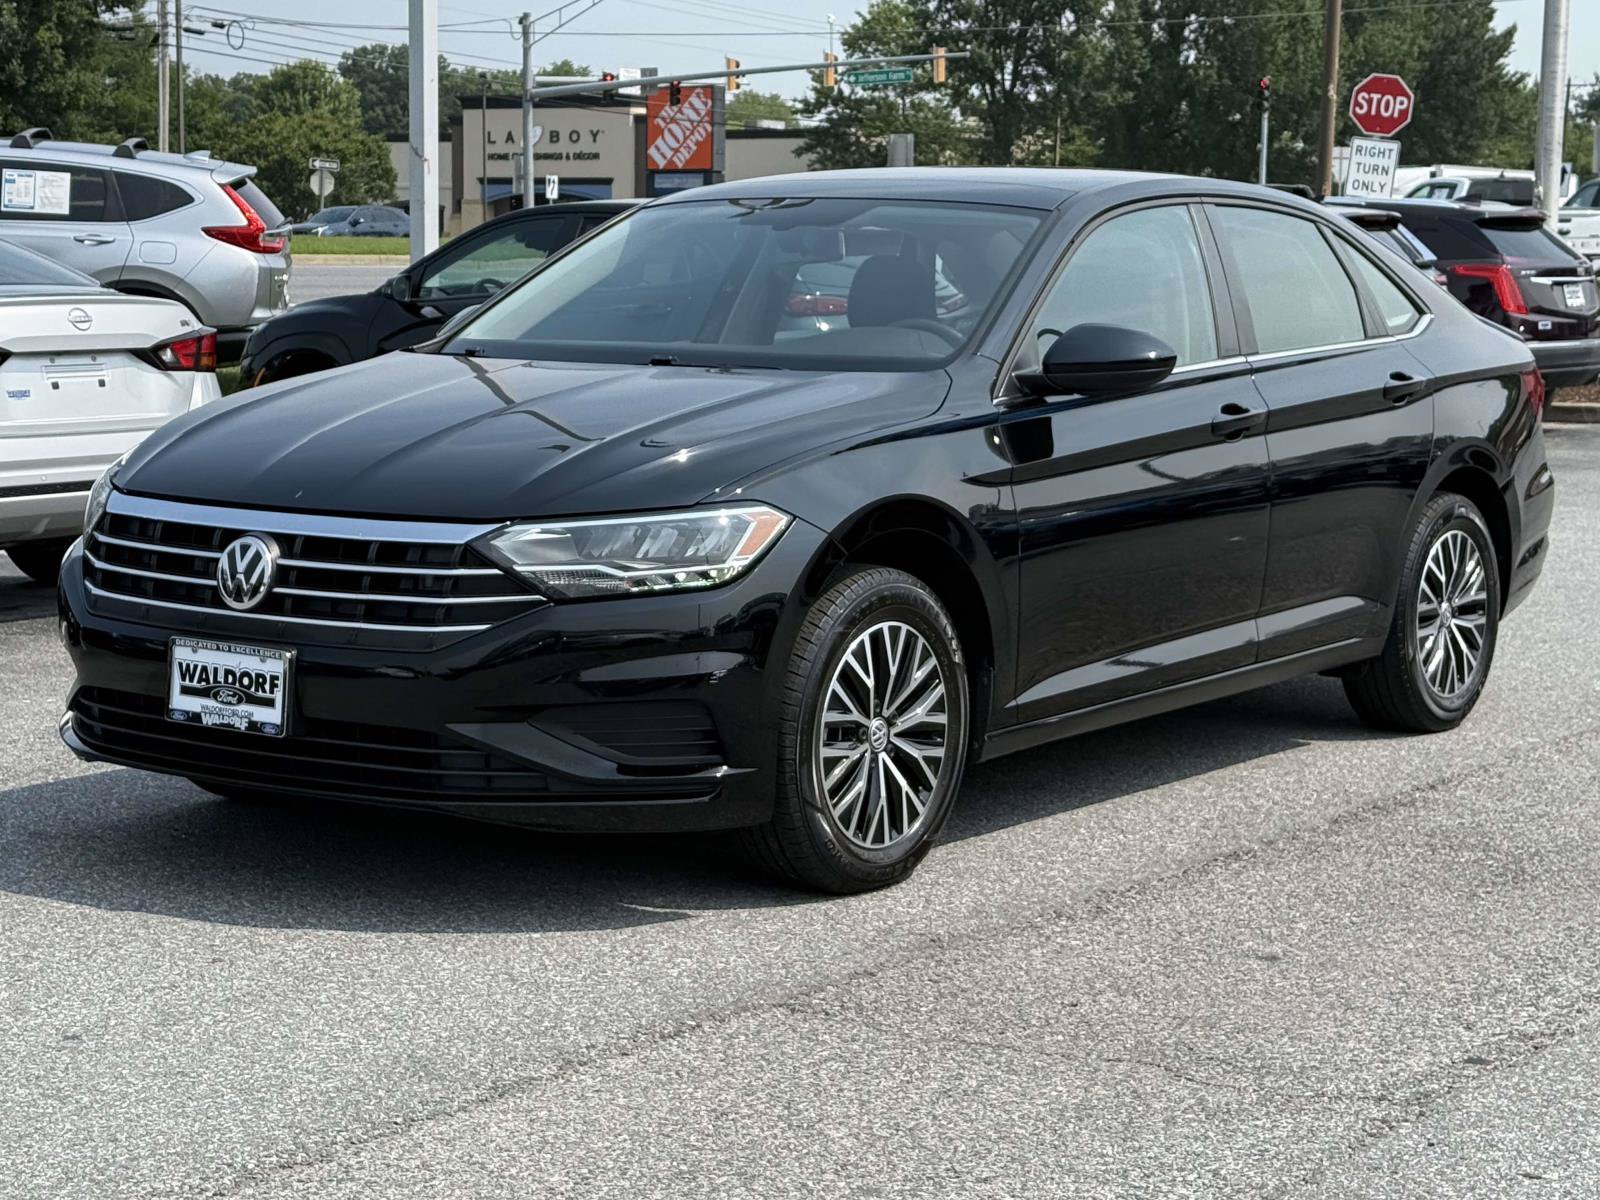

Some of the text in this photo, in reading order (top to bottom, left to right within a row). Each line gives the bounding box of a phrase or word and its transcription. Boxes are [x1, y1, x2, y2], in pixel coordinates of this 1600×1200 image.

[1355, 92, 1408, 118] STOP
[549, 129, 600, 144] BOY
[647, 88, 712, 169] HOME
[672, 116, 712, 169] DEPOT
[487, 152, 510, 160] HOME
[1355, 144, 1394, 159] RIGHT
[1356, 162, 1390, 176] TURN
[1352, 180, 1386, 193] ONLY
[175, 638, 217, 650] DEDICATED
[230, 645, 281, 659] EXCELLENCE
[178, 661, 280, 696] WALDORF
[217, 689, 239, 705] Ford
[201, 712, 249, 731] WALDORF
